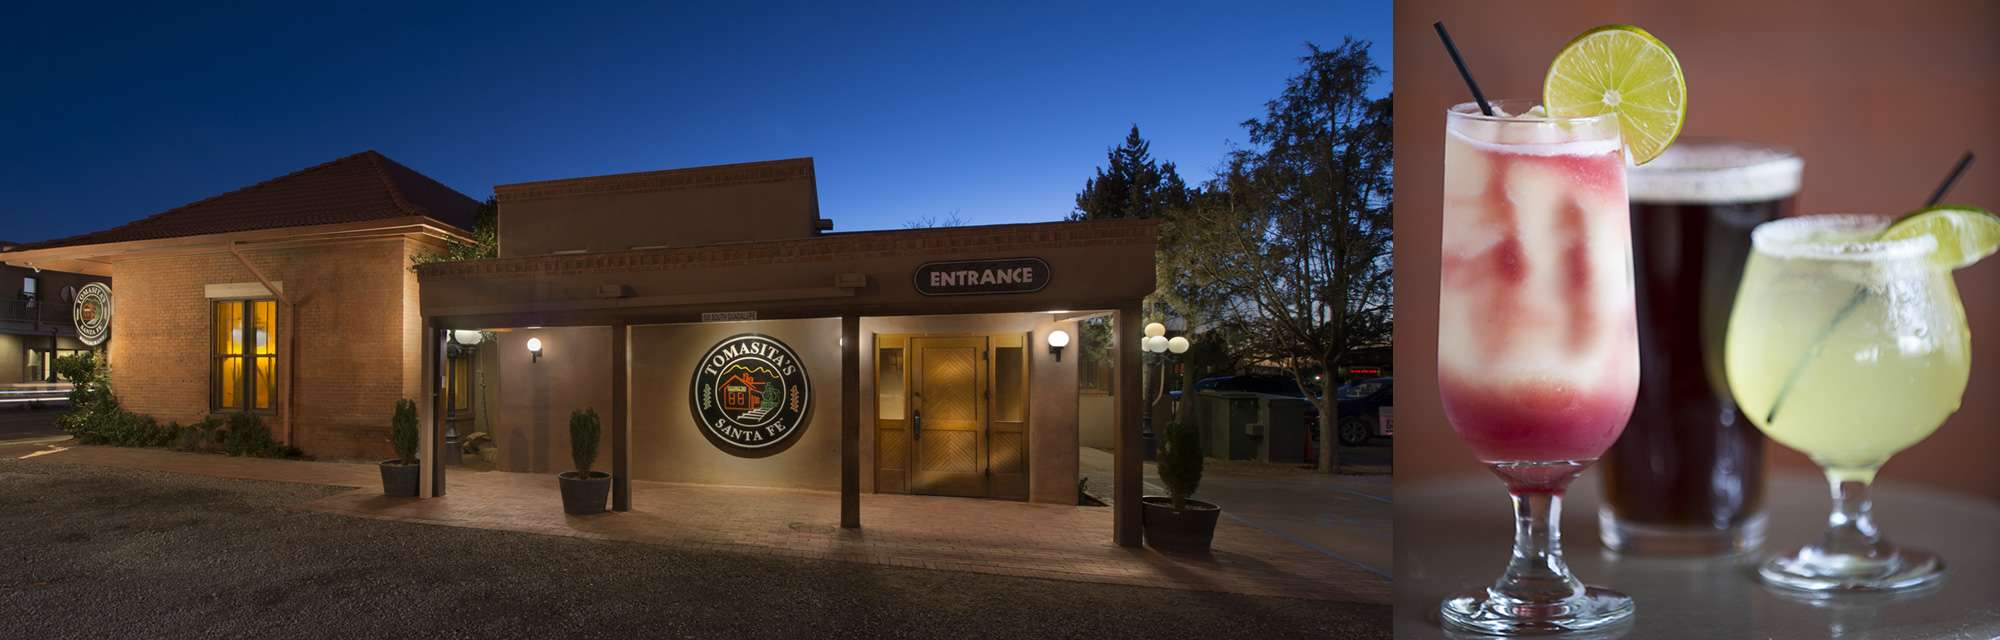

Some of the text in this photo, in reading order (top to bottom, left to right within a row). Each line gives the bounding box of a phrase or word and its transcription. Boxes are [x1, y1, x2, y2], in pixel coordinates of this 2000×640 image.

[930, 267, 1033, 287] ENTRANCE
[705, 341, 796, 376] TOMASITA'S
[715, 418, 763, 441] SANTA
